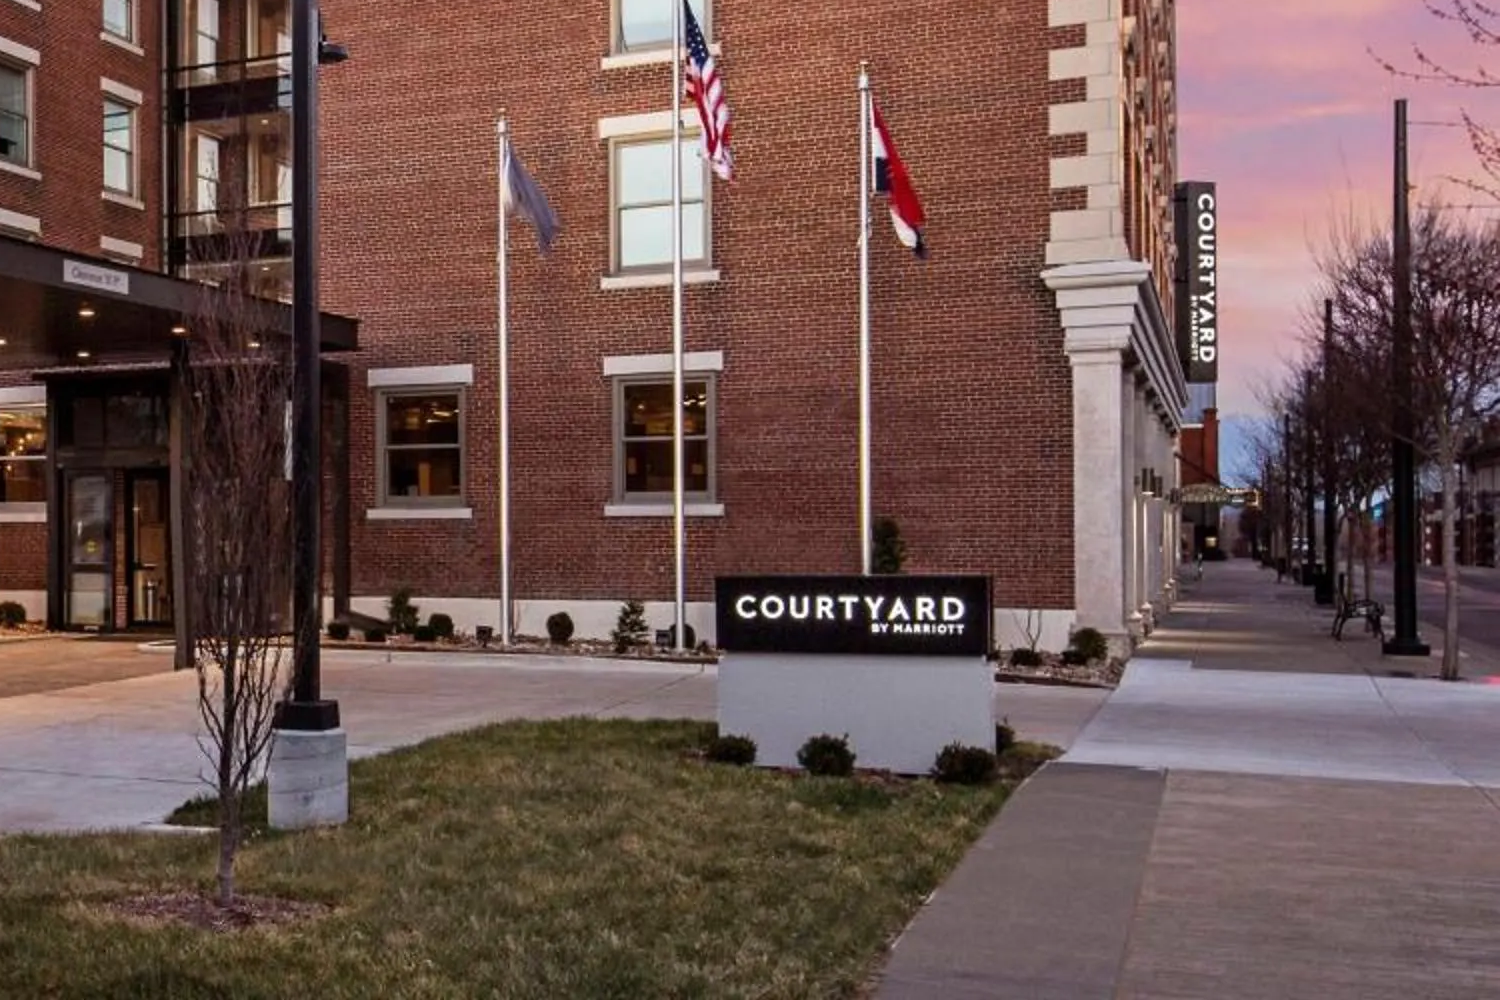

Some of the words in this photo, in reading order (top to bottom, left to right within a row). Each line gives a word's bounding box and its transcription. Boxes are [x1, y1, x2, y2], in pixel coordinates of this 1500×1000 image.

[1197, 193, 1216, 363] COURTYARD
[736, 595, 965, 621] COURTYARD
[871, 622, 888, 633] BY
[893, 623, 965, 635] MARRIOTT
